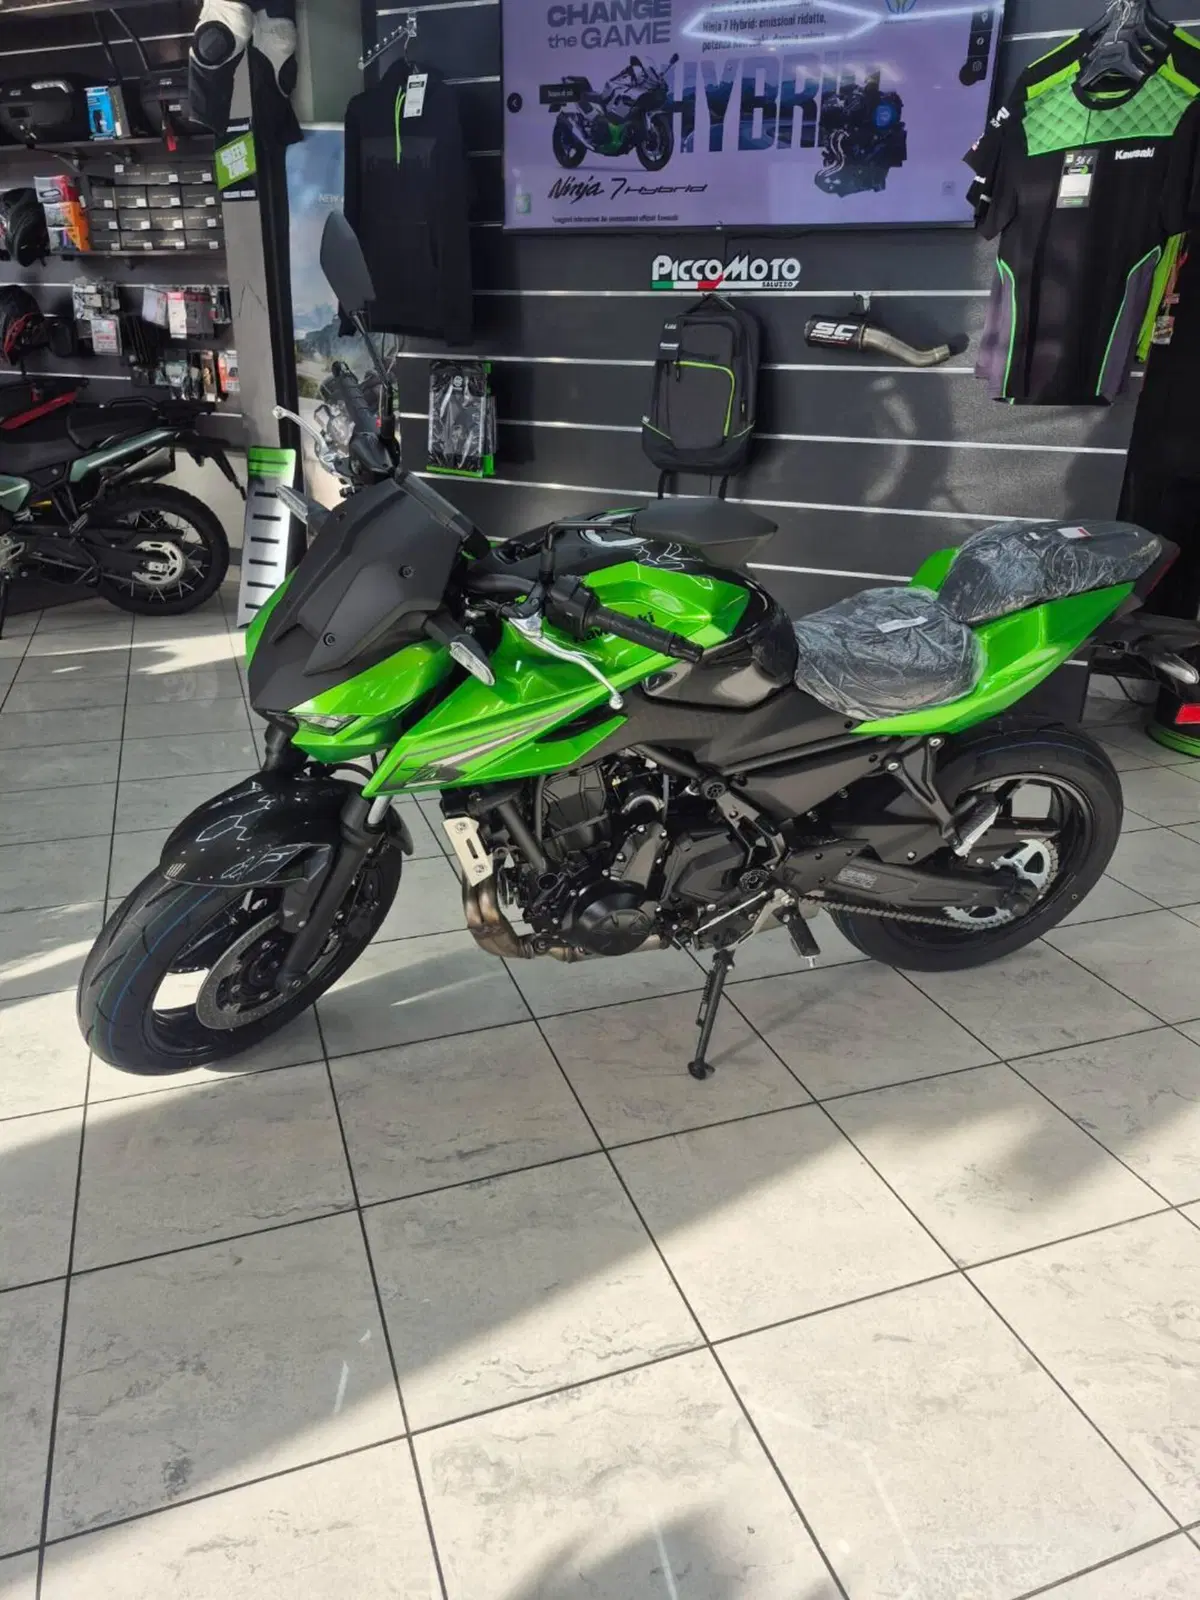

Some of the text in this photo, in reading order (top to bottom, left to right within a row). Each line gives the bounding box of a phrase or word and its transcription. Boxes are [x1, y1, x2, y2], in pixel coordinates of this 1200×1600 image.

[547, 0, 671, 27] CHANGE
[548, 20, 671, 49] the GAME
[1115, 147, 1155, 160] Kawasaki
[548, 175, 708, 204] Ninja 7 Hybrid
[761, 280, 794, 288] SALUZZO
[811, 321, 858, 338] SC
